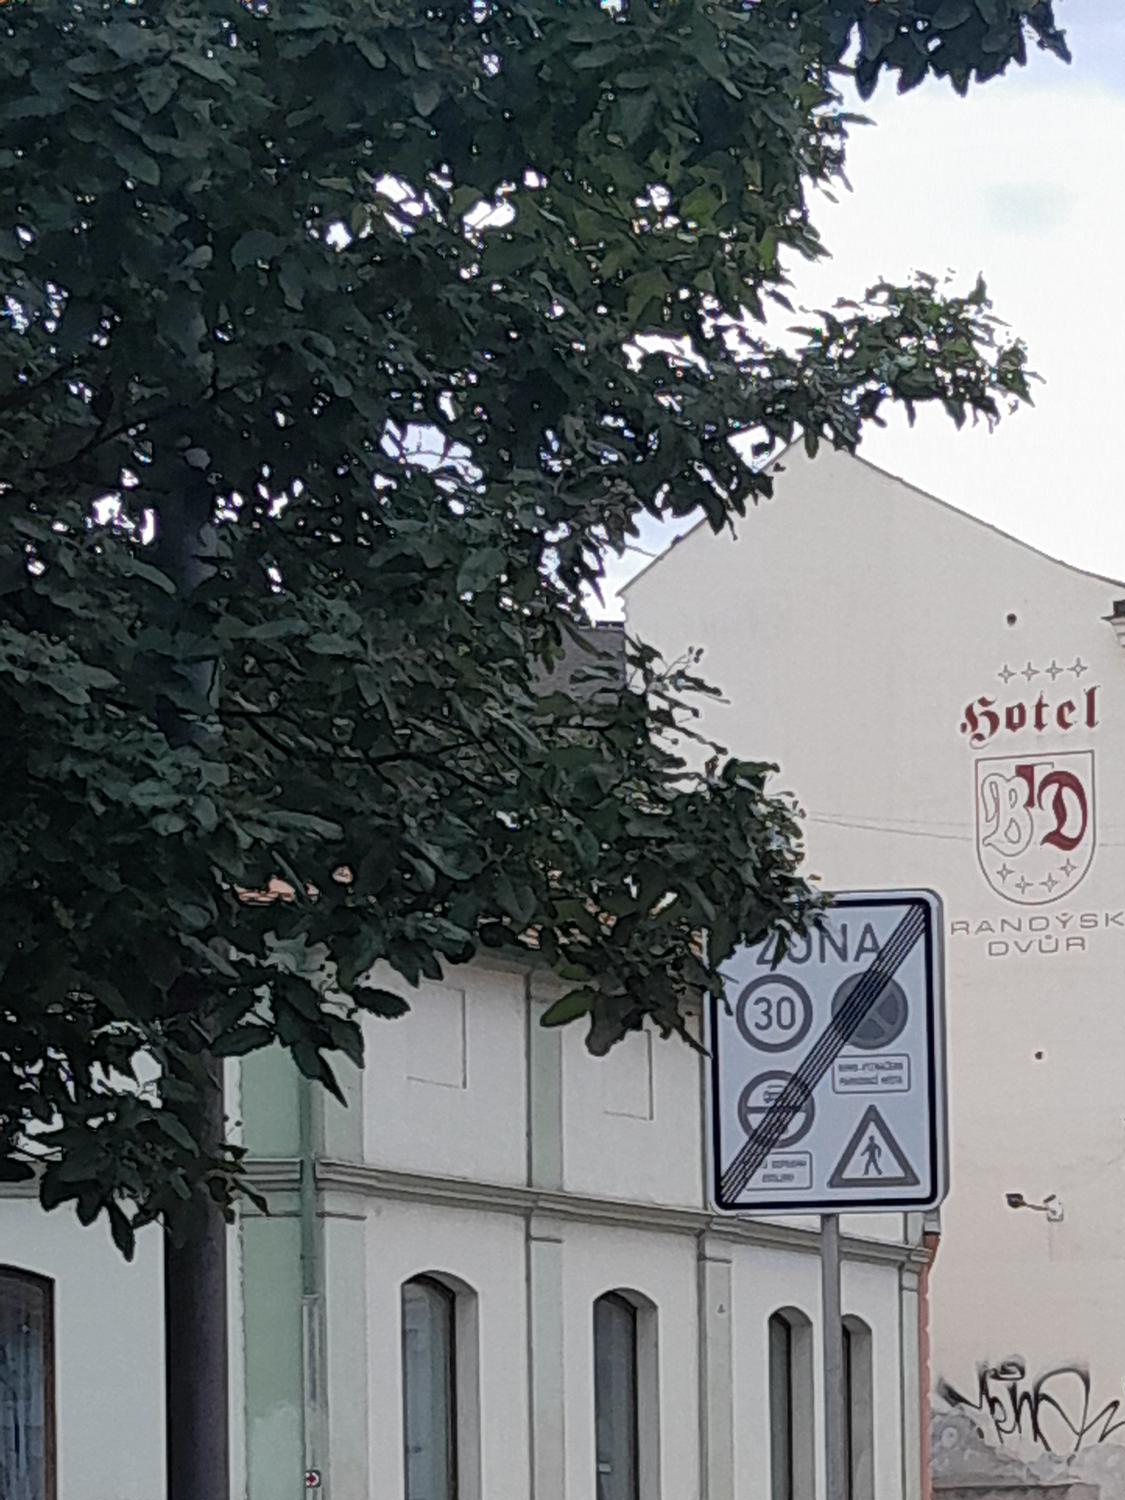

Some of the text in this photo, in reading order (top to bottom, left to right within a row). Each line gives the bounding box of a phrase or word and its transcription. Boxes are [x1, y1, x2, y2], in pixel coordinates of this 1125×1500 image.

[960, 685, 1101, 749] Hotel
[988, 934, 1086, 956] DVŮR
[753, 996, 796, 1031] 30
